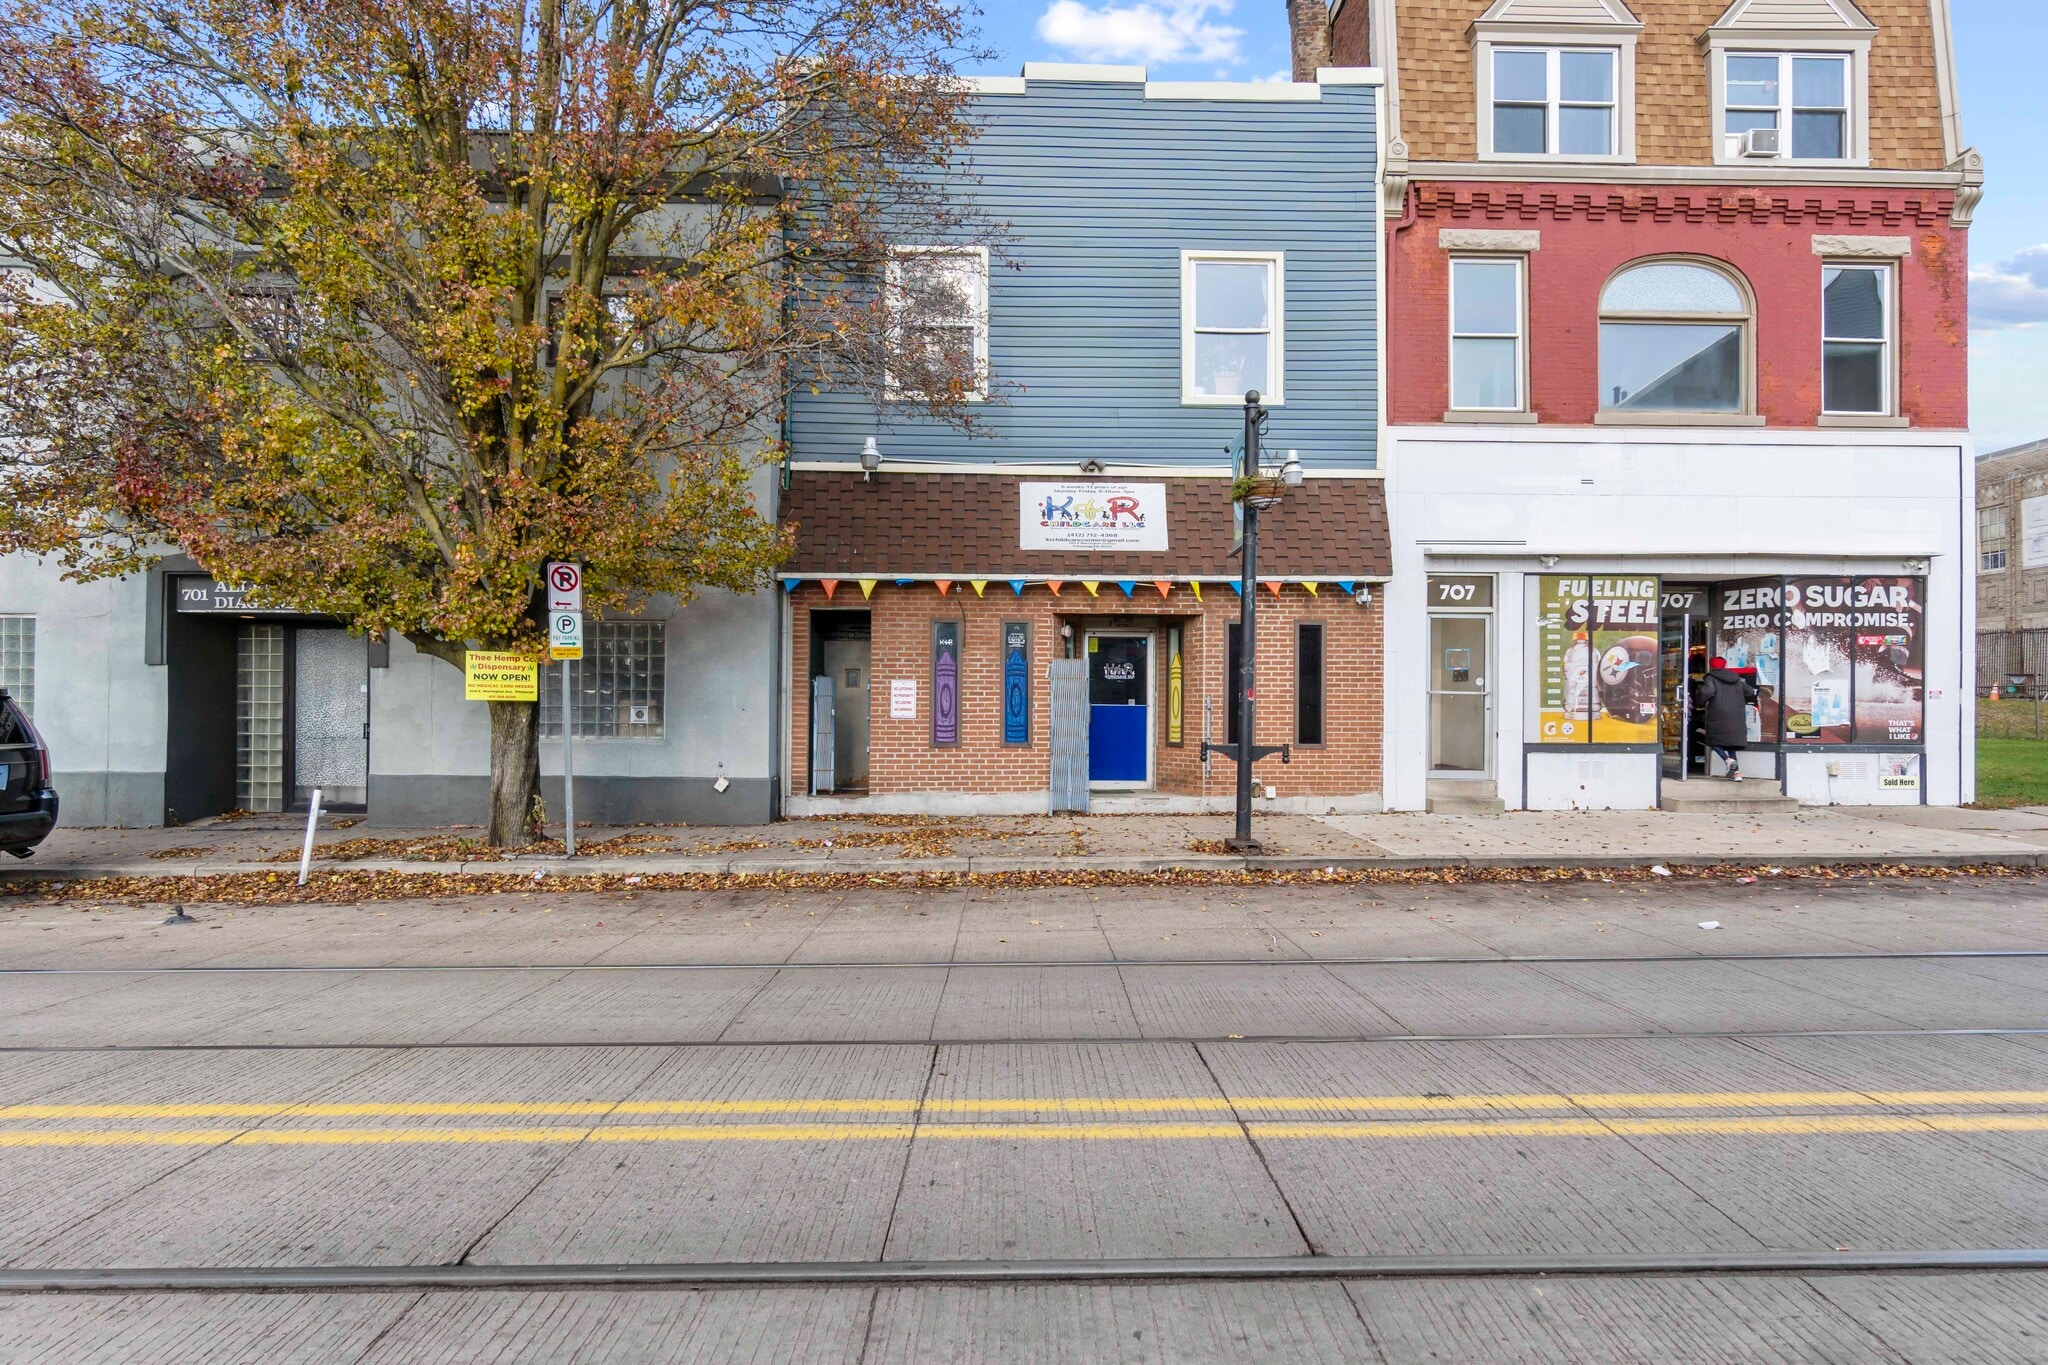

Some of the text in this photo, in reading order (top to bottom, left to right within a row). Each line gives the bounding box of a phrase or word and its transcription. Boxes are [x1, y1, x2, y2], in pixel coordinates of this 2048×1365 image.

[182, 589, 209, 601] 701
[1440, 584, 1476, 600] 707
[1558, 579, 1655, 597] FUELING
[1661, 593, 1694, 608] 707
[1724, 585, 1914, 611] ZERO SUGAR.
[1570, 599, 1658, 623] STEEL
[1723, 613, 1769, 630] ZERO
[477, 663, 526, 671] Dispensary
[1884, 778, 1915, 786] Sold Here
